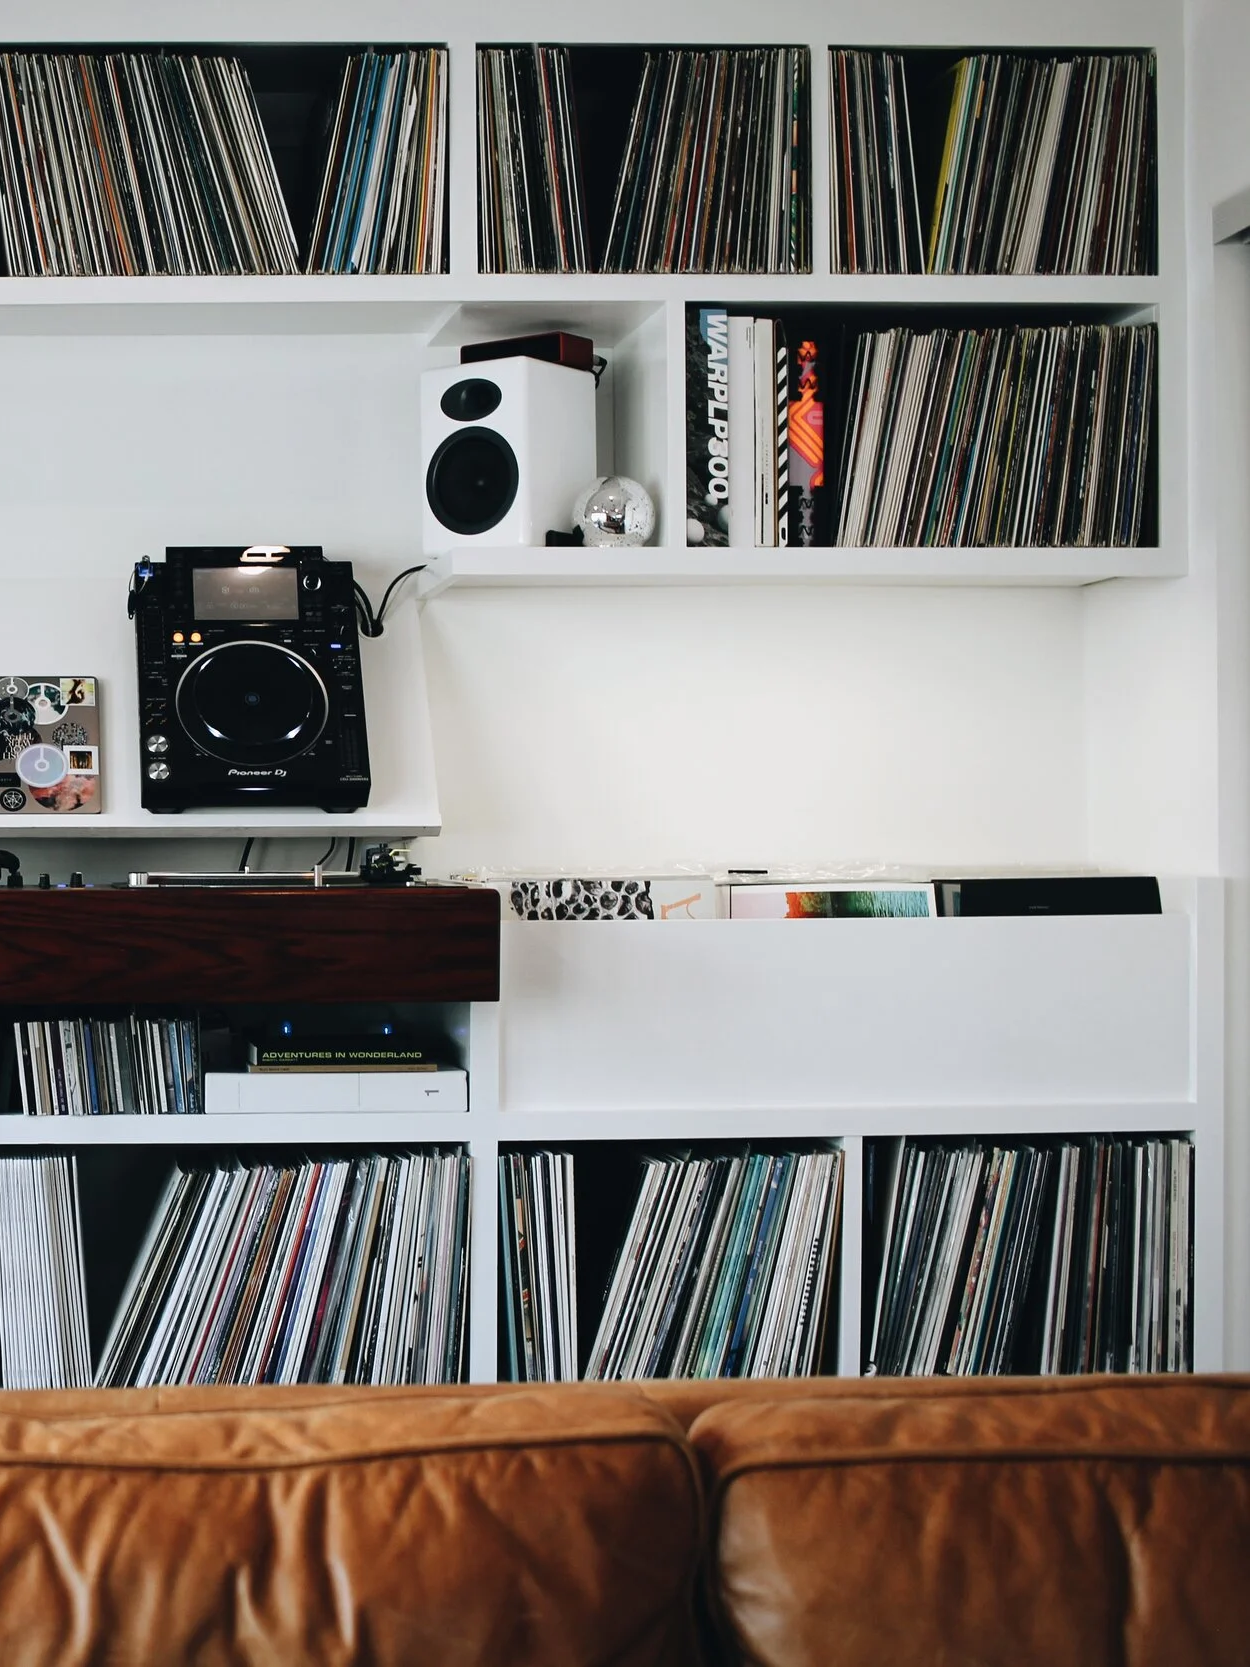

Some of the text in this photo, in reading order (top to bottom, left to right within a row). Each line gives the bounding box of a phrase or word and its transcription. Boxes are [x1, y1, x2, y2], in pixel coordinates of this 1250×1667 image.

[707, 314, 729, 503] WARPLP300
[227, 768, 273, 776] Pioneer
[261, 1051, 423, 1059] ADVENTURES IN WONDERLAND
